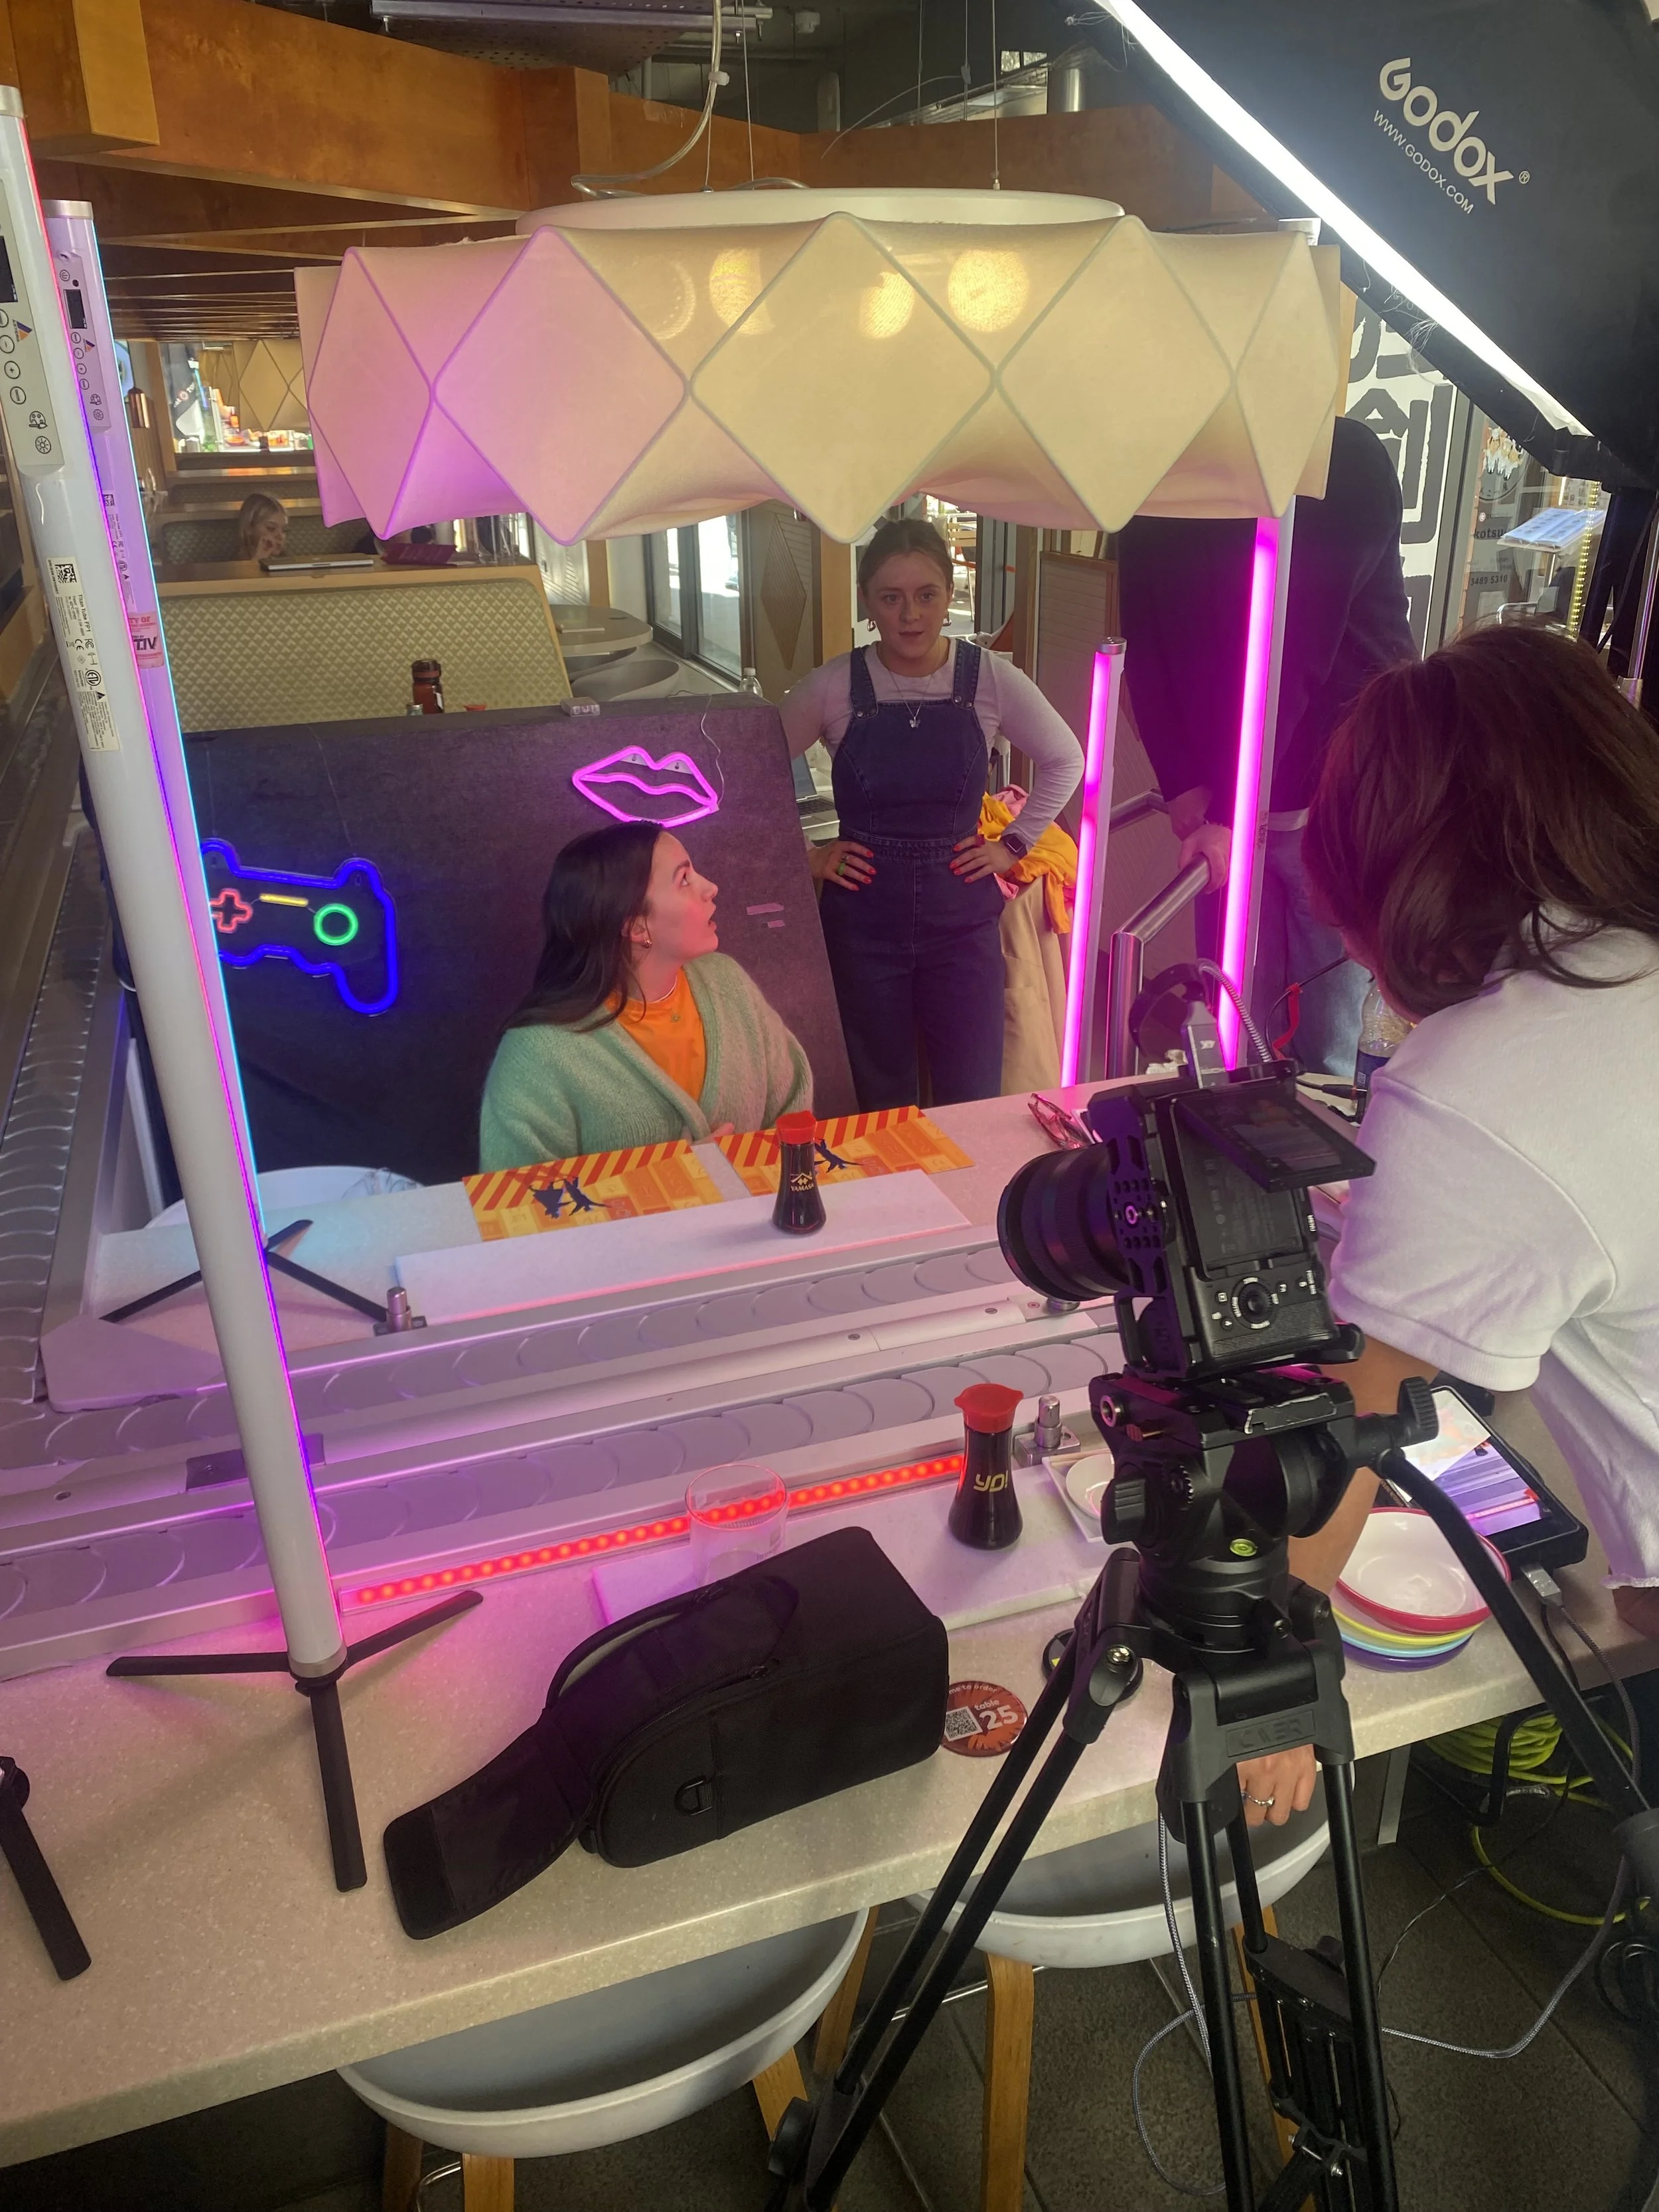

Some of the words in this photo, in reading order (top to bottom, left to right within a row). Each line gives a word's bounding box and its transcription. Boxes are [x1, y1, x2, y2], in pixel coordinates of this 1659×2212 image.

[1374, 110, 1474, 214] WWW.GODOX.COM
[1491, 575, 1508, 584] 5310
[790, 1183, 814, 1192] YAMASA
[1307, 1215, 1317, 1232] MENU
[974, 1684, 998, 1693] order
[974, 1700, 1000, 1711] table
[979, 1704, 1019, 1731] 25
